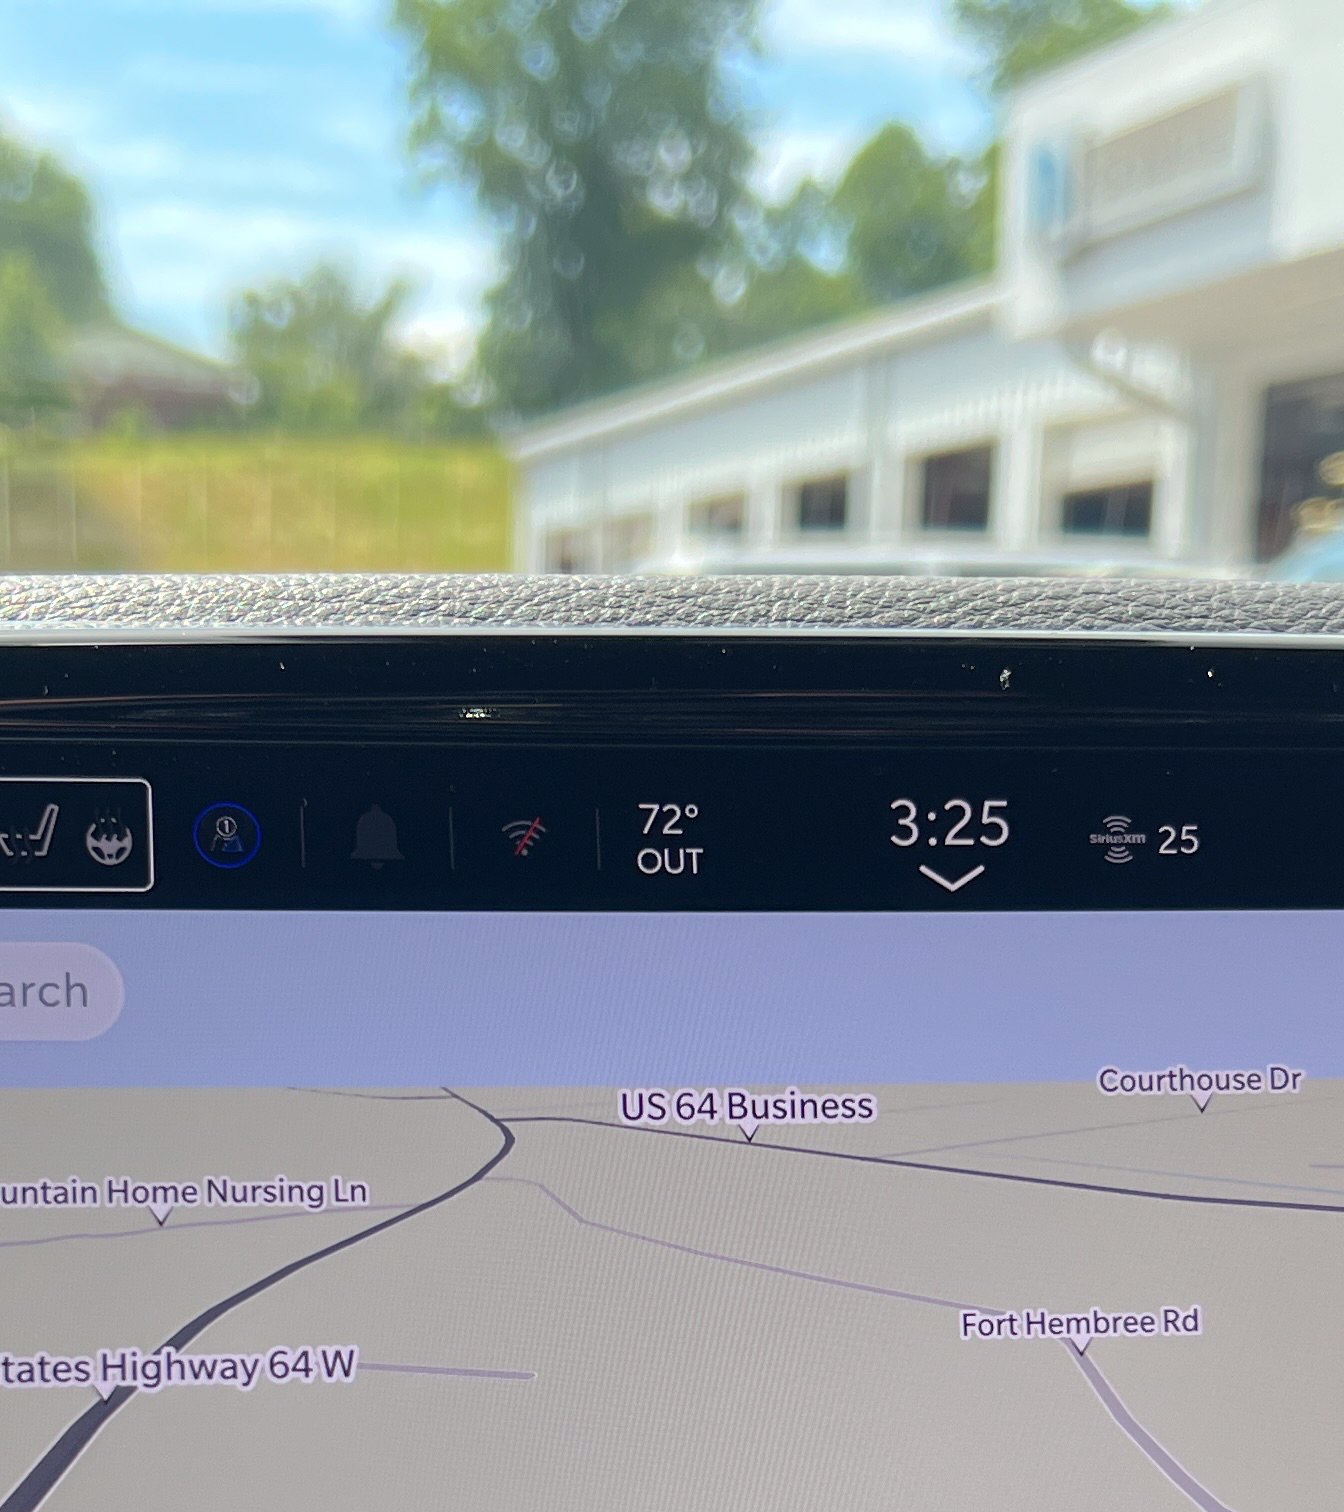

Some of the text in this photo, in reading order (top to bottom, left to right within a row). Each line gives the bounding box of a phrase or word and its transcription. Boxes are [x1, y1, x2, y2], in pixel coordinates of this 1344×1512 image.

[637, 804, 699, 836] 72°
[889, 799, 1010, 847] 3:25
[1158, 825, 1199, 854] 25
[637, 848, 704, 876] OUT
[1098, 1068, 1302, 1094] Courthouse Dr
[621, 1090, 874, 1121] US 64 Business
[108, 1180, 198, 1204] Home
[207, 1177, 324, 1208] Nursing
[333, 1177, 368, 1203] Ln
[962, 1309, 1199, 1338] Fort Hembree Rd
[101, 1351, 259, 1387] Highway
[268, 1350, 312, 1379] 64
[321, 1349, 355, 1379] W
